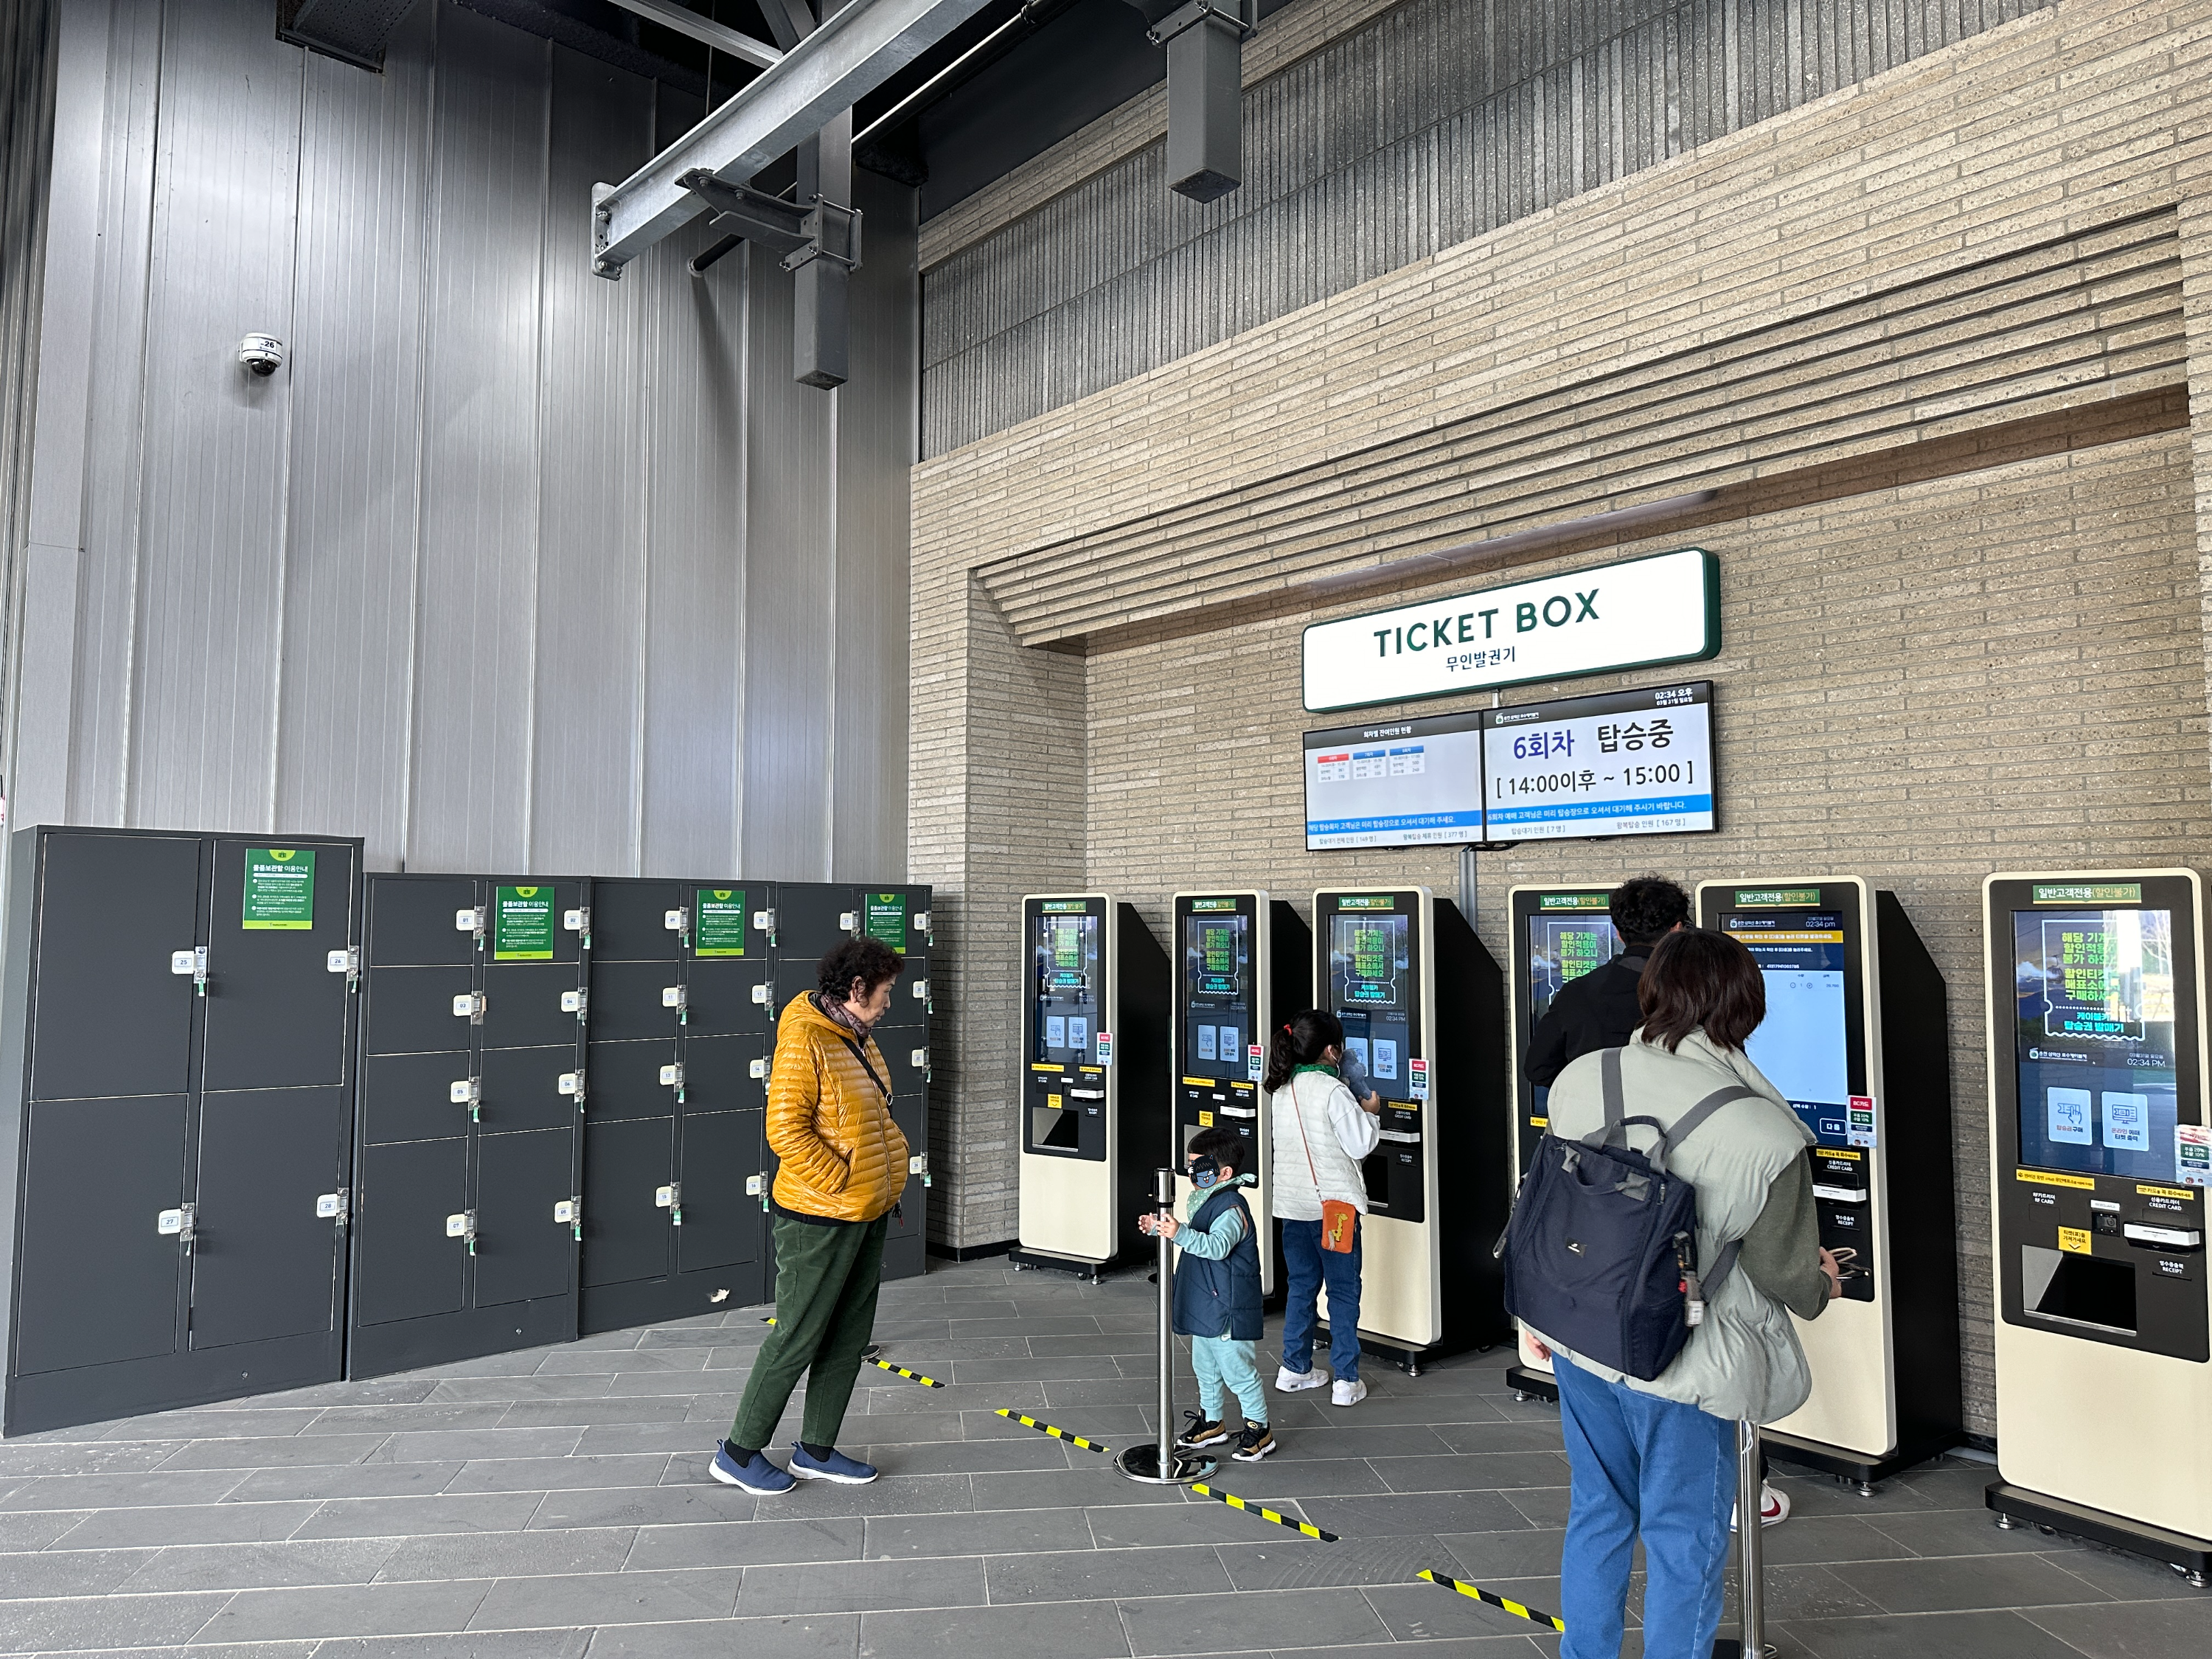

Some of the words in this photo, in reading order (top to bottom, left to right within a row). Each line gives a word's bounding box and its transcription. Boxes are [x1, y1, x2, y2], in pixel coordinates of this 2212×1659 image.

[1374, 608, 1499, 657] TICKET
[1517, 588, 1600, 633] BOX
[1446, 646, 1515, 672] 무인발권기
[1655, 690, 1677, 700] 02:34
[1677, 687, 1693, 697] 오후
[1514, 729, 1574, 759] 6회차
[1598, 719, 1674, 753] 탑승중
[1509, 770, 1596, 795] 14:00이후
[1623, 764, 1680, 786] 15:00
[1487, 813, 1503, 821] 6회차
[1518, 810, 1543, 819] 고객님은
[1543, 810, 1556, 818] 미리
[1557, 807, 1590, 817] 탑승장으로
[1591, 805, 1610, 814] 오셔서
[1612, 804, 1632, 813] 대기해
[1634, 803, 1655, 812] 주시기
[1656, 801, 1686, 810] 바랍니다.
[1340, 821, 1360, 830] 고객님은
[1373, 819, 1399, 827] 탑승장으로
[1418, 817, 1436, 825] 대기해
[1641, 820, 1654, 828] 인원
[1512, 827, 1532, 835] 탑승대기
[1739, 891, 1816, 902] 일반고객전용(할인불가)
[2039, 886, 2135, 898] 일반고객전용(할인불가)
[1559, 932, 1574, 940] 해당
[1576, 932, 1598, 940] 기계는
[2062, 932, 2084, 943] 해당
[1562, 940, 1596, 948] 할인적용이
[1560, 949, 1574, 957] 불가
[1576, 949, 1598, 957] 하오니
[2063, 954, 2084, 964] 불가
[2065, 1020, 2093, 1031] 탑승권
[2095, 1023, 2124, 1032] 발매기
[2127, 1058, 2150, 1066] 02:34
[2162, 1266, 2183, 1274] RECEIPT
